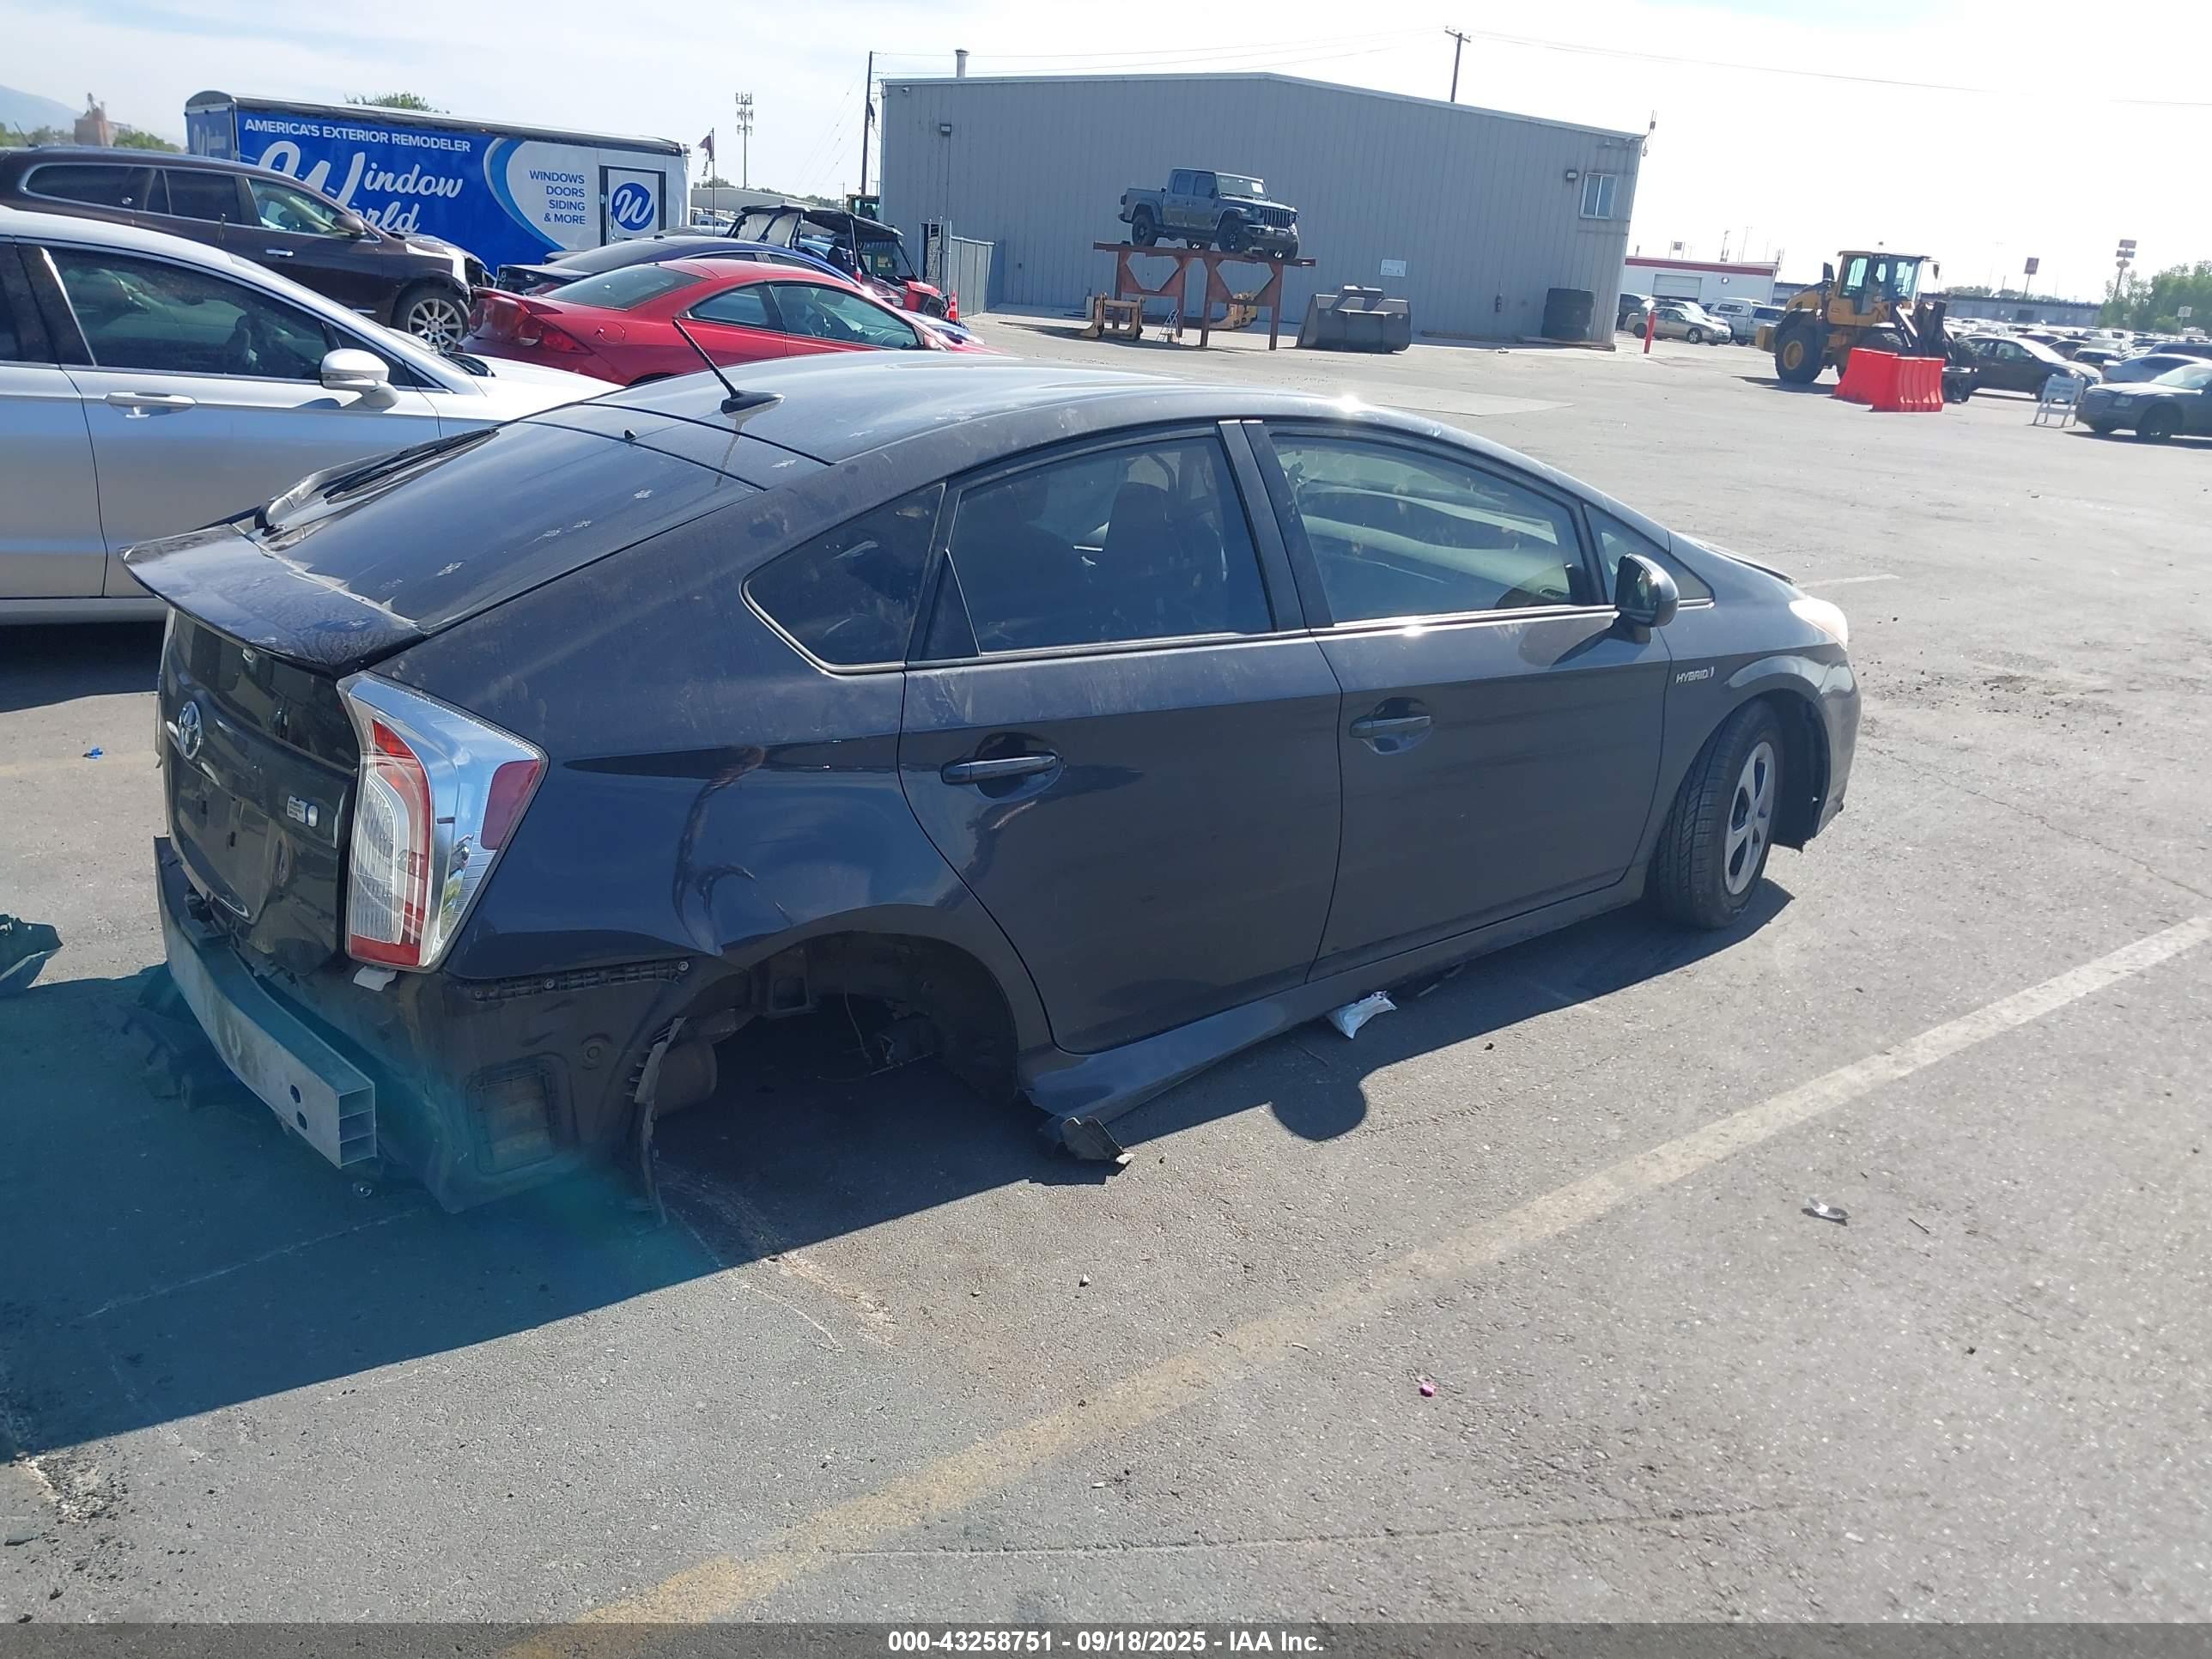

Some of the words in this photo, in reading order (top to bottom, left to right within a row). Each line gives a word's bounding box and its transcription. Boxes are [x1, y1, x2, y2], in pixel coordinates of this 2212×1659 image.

[244, 119, 320, 137] AMERICA'S
[323, 126, 389, 145] EXTERIOR
[392, 134, 471, 153] REMODELER
[529, 170, 585, 184] WINDOWS
[546, 185, 586, 198] DOORS
[549, 199, 586, 211] SIDING
[544, 214, 551, 222] &
[554, 215, 586, 225] MORE
